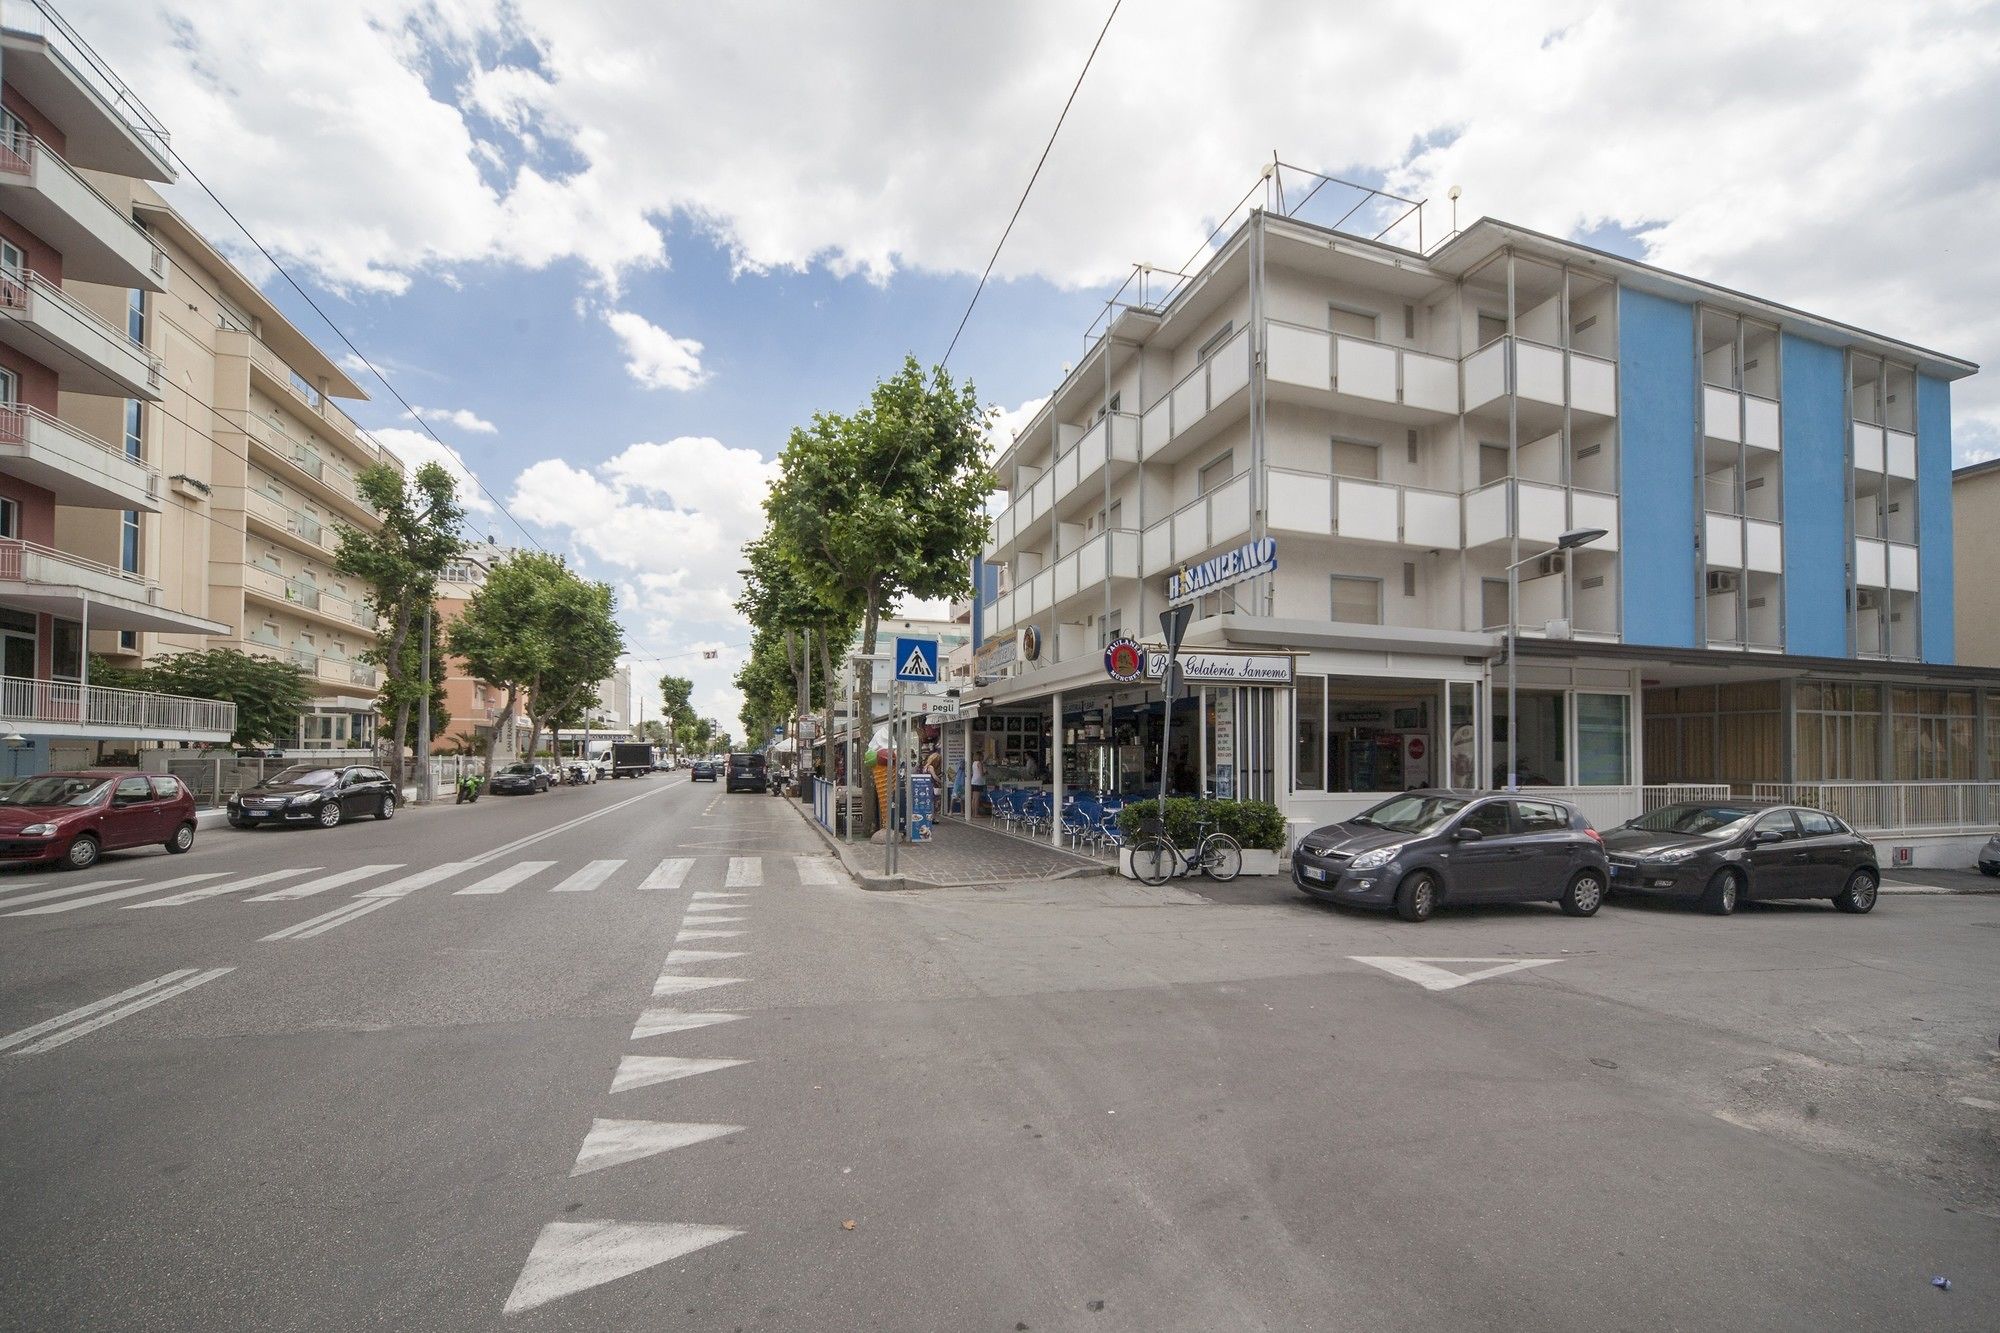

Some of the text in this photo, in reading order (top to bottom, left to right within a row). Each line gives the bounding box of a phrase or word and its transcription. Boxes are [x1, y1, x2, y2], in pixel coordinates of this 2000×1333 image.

[1169, 537, 1277, 600] H SANREMO
[705, 651, 716, 659] 27
[1106, 640, 1143, 656] PAULANER
[1185, 655, 1235, 677] Gelateria
[1238, 657, 1288, 678] Sanremo
[1110, 670, 1141, 682] MÜNCHEN
[932, 704, 954, 712] pegli
